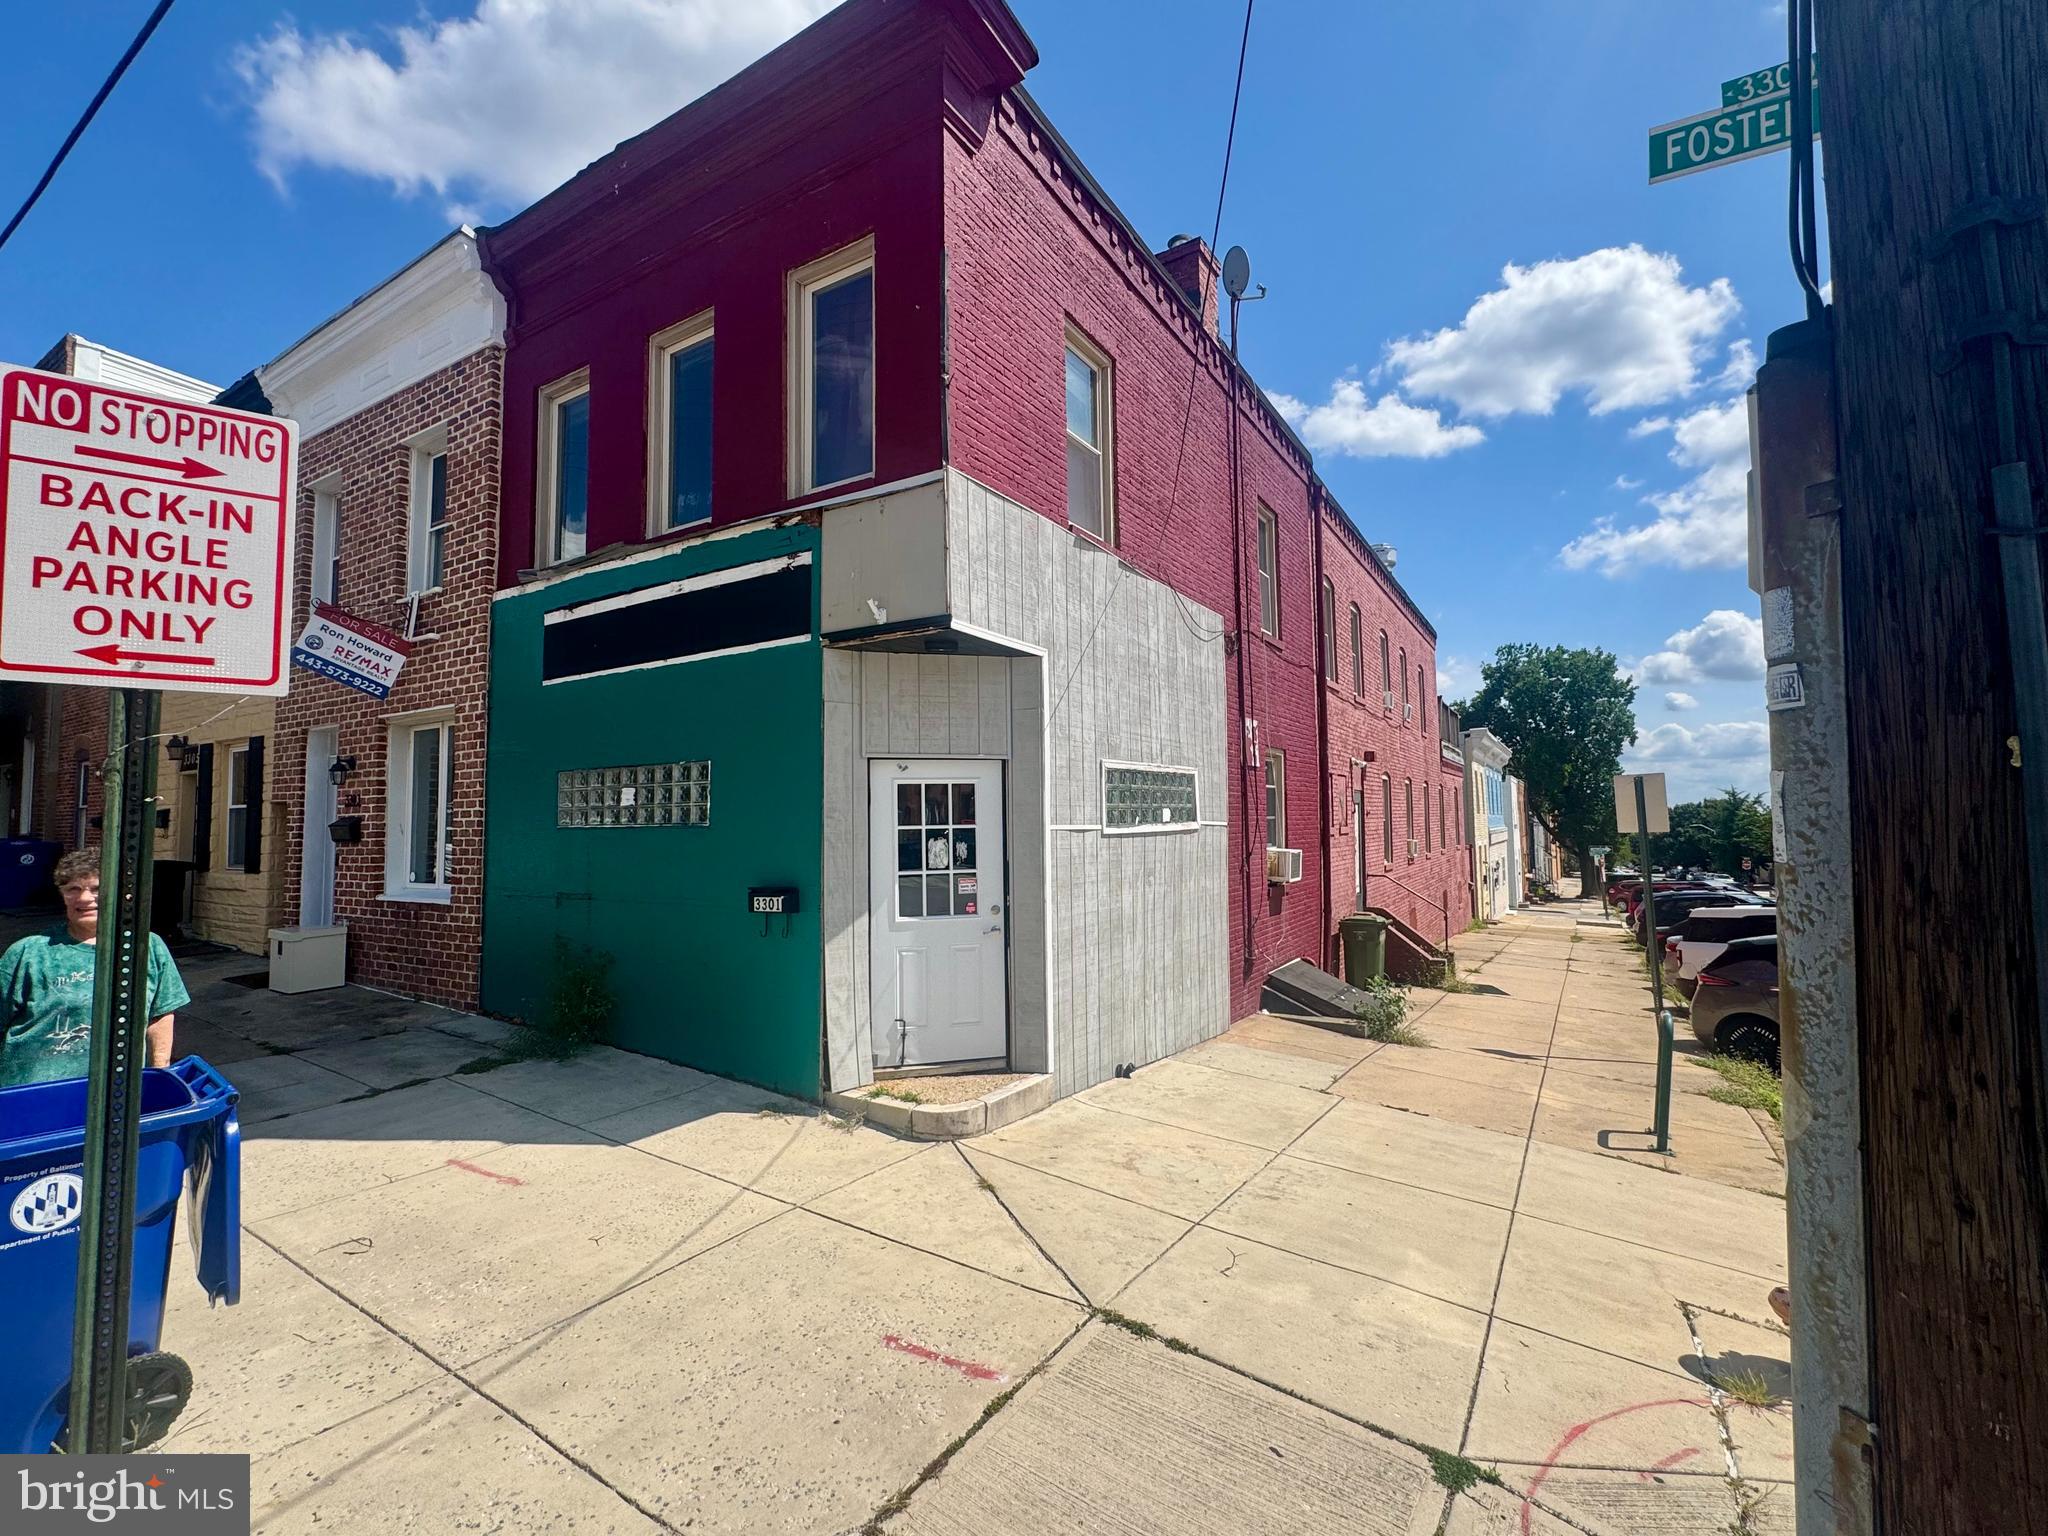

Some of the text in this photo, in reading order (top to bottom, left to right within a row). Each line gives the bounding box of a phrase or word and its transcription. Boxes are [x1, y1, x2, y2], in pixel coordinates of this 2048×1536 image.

[16, 379, 276, 463] NO STOPPING
[40, 473, 253, 534] BACK-IN
[66, 521, 228, 570] ANGLE
[32, 556, 253, 609] PARKING
[73, 605, 216, 644] ONLY
[320, 624, 393, 662] Ron Howard
[330, 612, 399, 648] FOR SALE
[295, 653, 383, 696] 443-573-9222
[333, 645, 393, 678] RE/MAX
[755, 898, 780, 911] 3301
[4, 1171, 38, 1183] Property
[0, 1235, 41, 1250] epartment
[43, 1231, 51, 1240] of
[52, 1227, 76, 1238] Public
